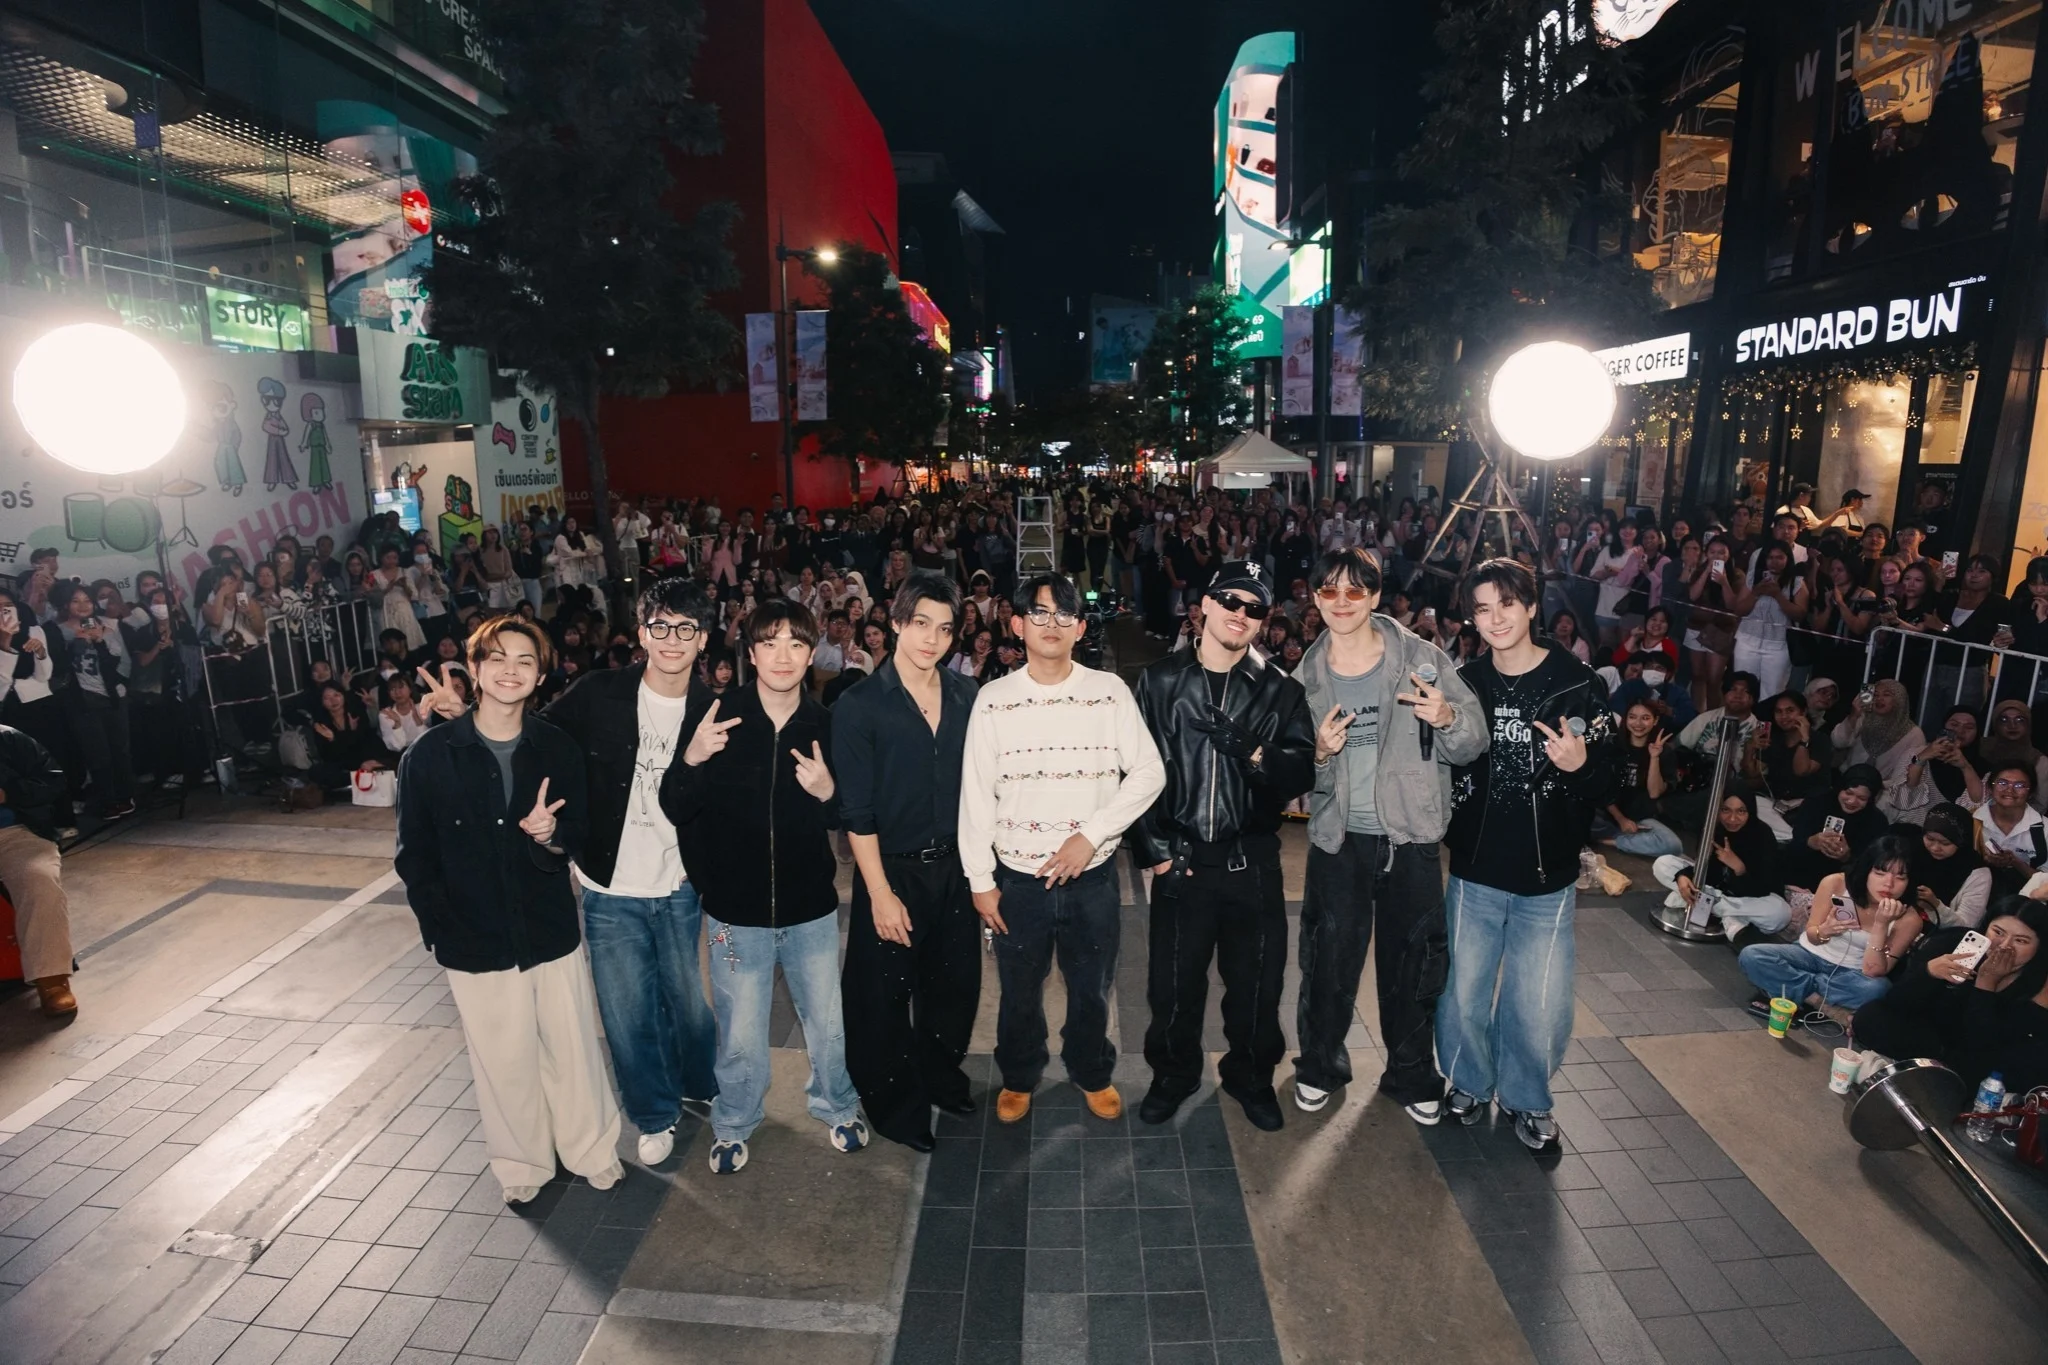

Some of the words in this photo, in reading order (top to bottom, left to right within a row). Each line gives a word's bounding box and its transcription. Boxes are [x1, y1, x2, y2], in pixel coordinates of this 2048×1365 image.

[214, 300, 287, 332] STORY
[1736, 306, 1878, 363] STANDARD
[1887, 287, 1962, 343] BUN
[1636, 347, 1685, 372] COFFEE
